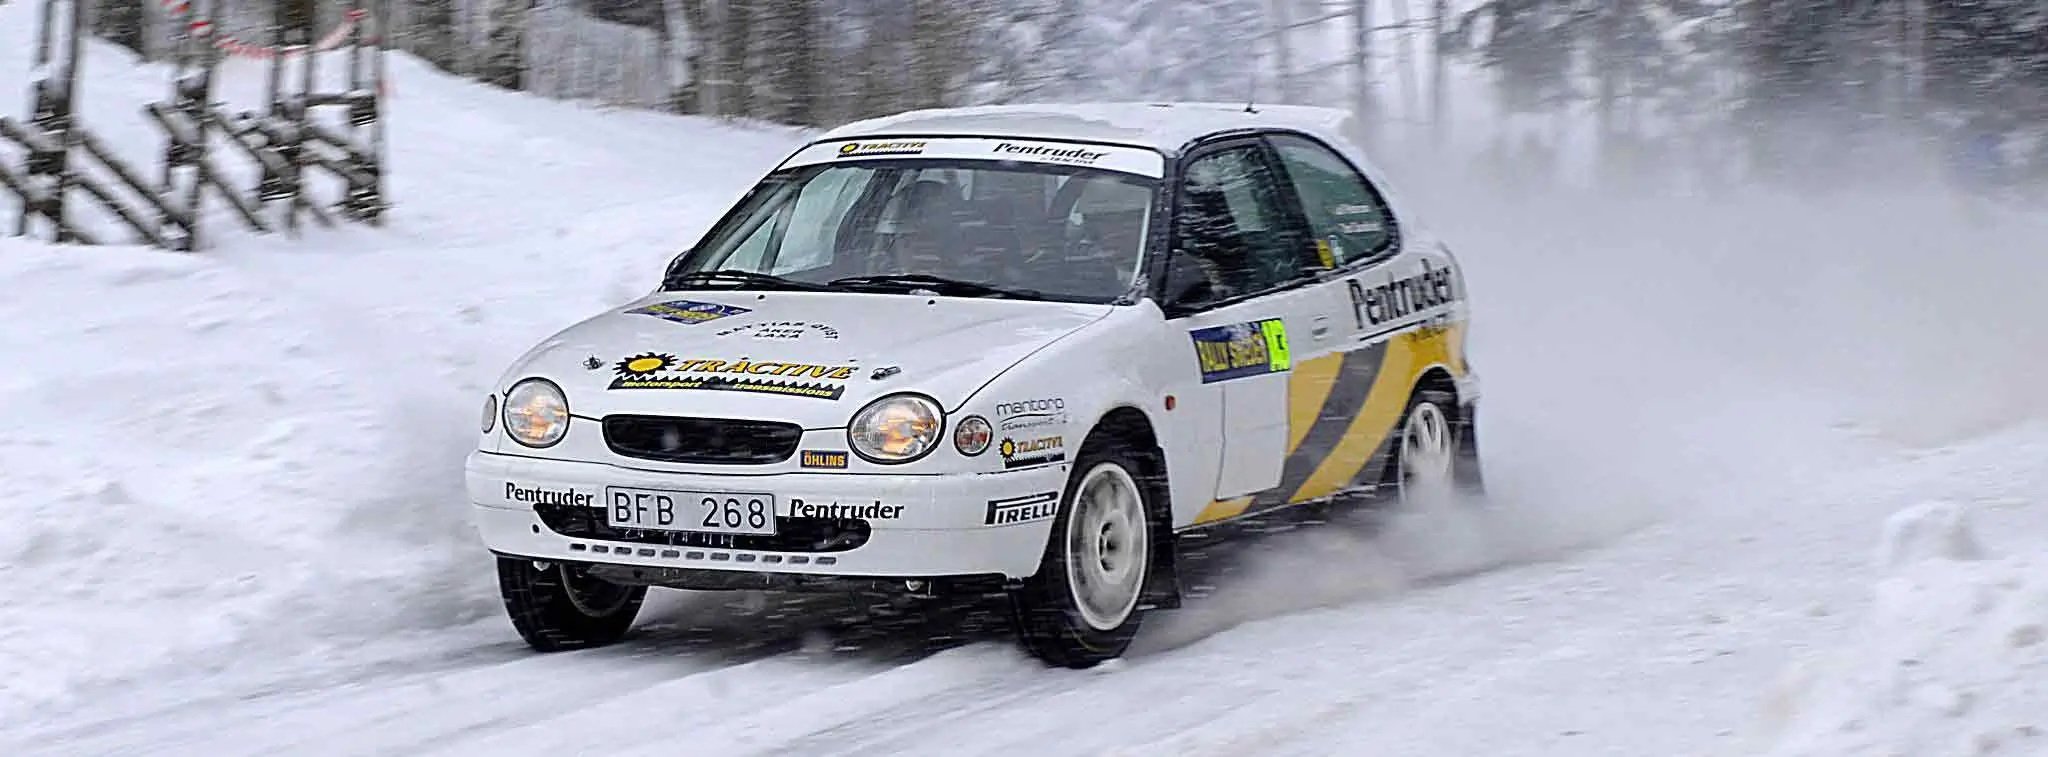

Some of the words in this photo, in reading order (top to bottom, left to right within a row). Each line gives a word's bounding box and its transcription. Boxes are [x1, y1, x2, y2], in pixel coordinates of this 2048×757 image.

[993, 142, 1112, 160] Pentruder
[1345, 258, 1454, 330] Pentruder
[676, 358, 859, 380] TRACTIVE
[622, 380, 703, 390] motorsport
[733, 382, 834, 398] transmissions
[804, 450, 846, 467] ÖHLINS
[505, 481, 594, 507] Pentruder
[614, 491, 675, 525] BFB
[701, 496, 767, 529] 268
[789, 498, 905, 520] Pentruder
[985, 491, 1060, 525] PIRELLI
